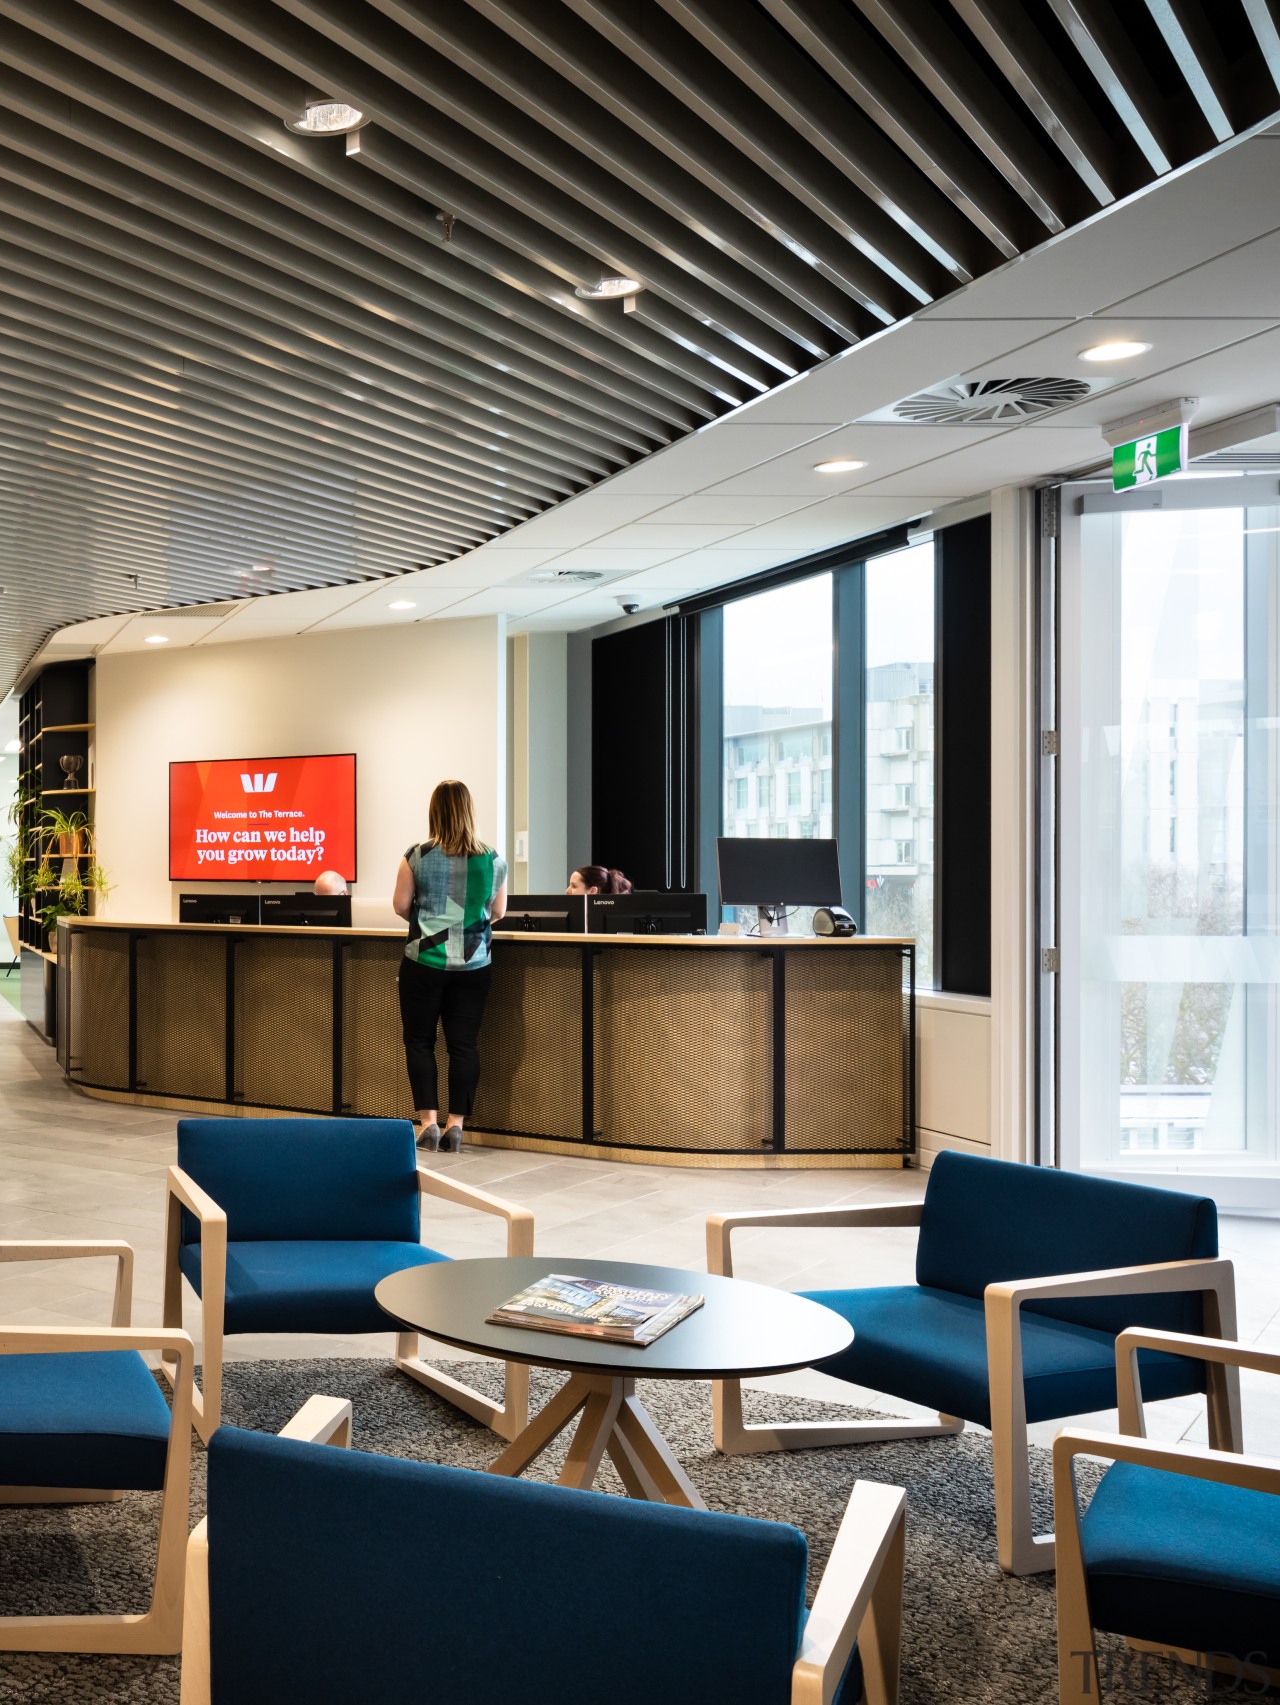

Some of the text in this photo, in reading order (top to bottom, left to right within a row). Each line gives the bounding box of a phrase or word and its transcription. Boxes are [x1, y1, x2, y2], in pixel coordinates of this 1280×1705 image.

[213, 809, 305, 819] Welcome to The Terrace.
[196, 826, 326, 846] How can we help
[197, 846, 324, 864] you grow today?
